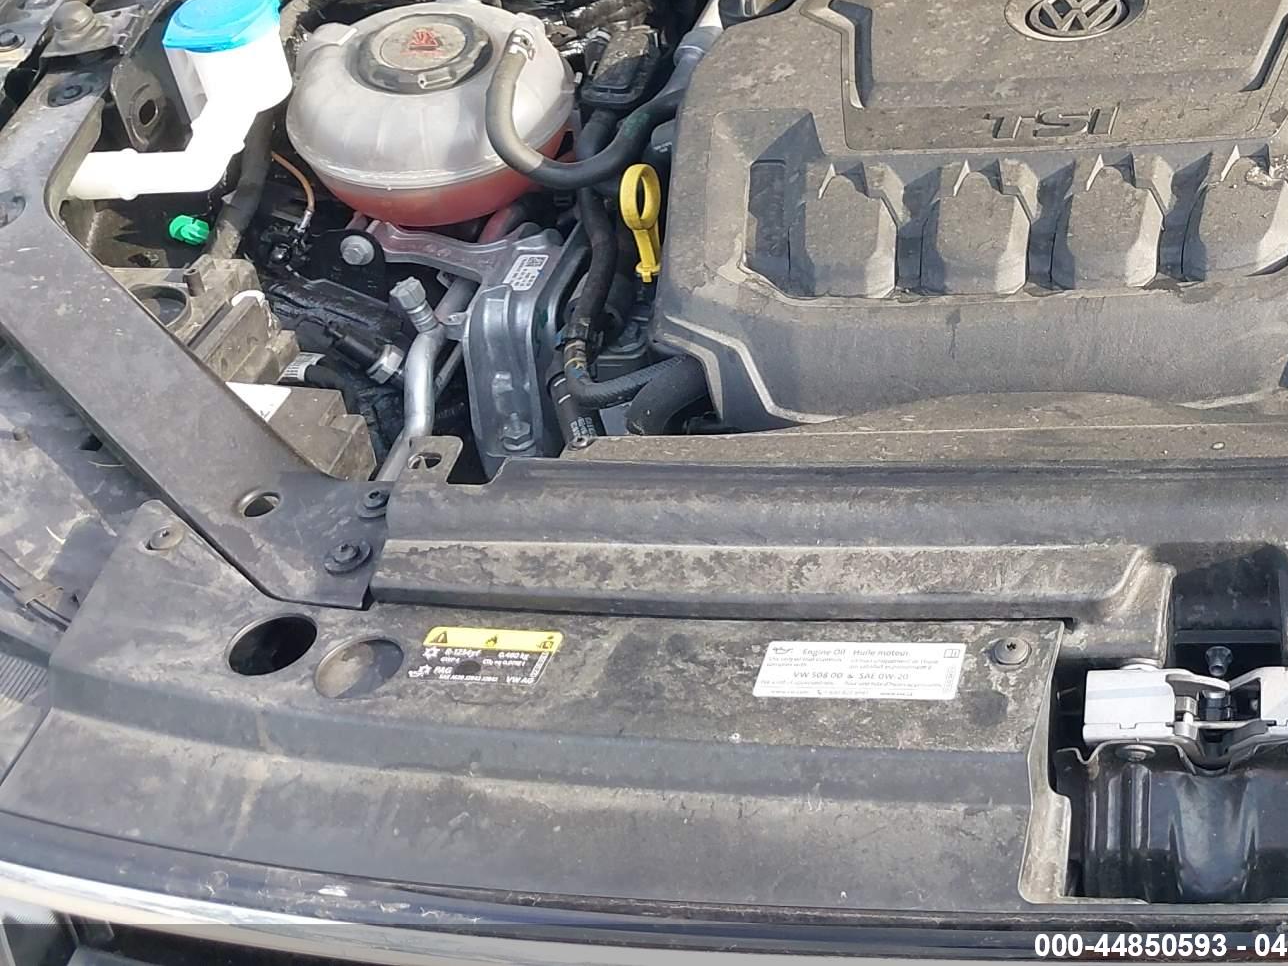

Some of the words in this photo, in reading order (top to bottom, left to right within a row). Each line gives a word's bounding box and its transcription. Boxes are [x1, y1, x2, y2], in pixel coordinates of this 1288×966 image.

[984, 102, 1121, 139] TSI
[444, 649, 482, 658] R-1234yf
[802, 648, 831, 657] Engine
[433, 666, 453, 674] PAG
[506, 676, 521, 684] VW
